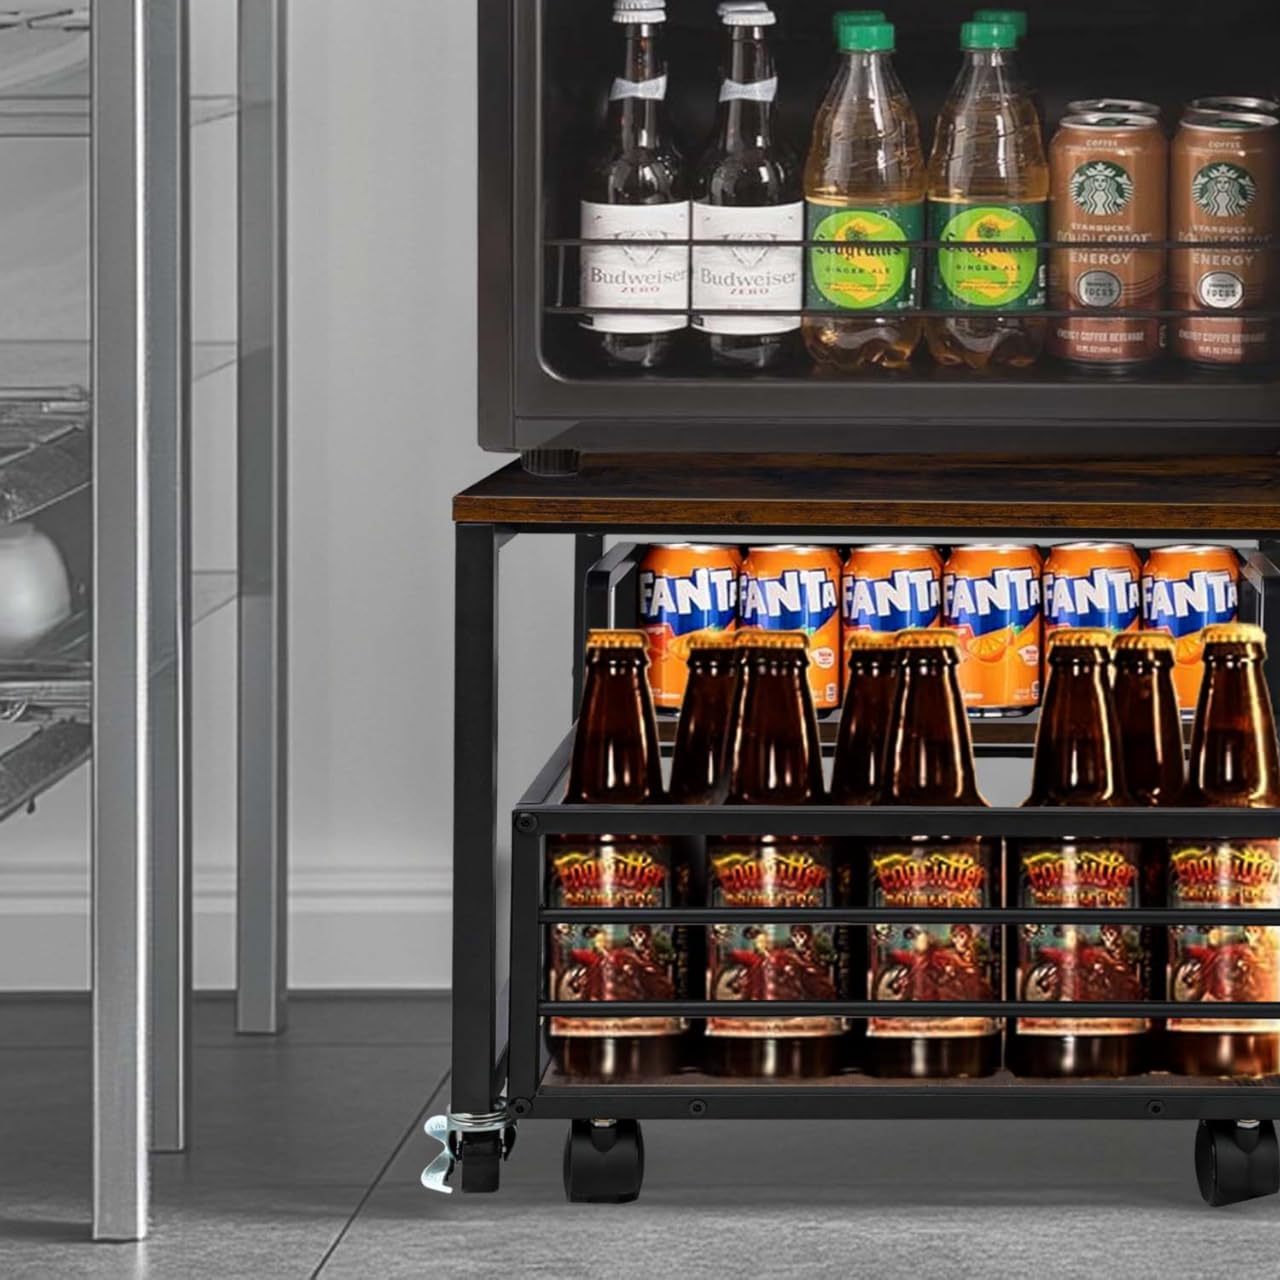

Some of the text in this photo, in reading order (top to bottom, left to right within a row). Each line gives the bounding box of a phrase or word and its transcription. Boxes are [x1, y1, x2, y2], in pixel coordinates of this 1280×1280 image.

[1070, 252, 1132, 265] ENERGY
[1190, 252, 1256, 266] ENERGY
[591, 266, 688, 287] Budweiser
[698, 267, 797, 288] Budweiser
[740, 569, 837, 618] FANTA
[943, 568, 1040, 618] FANTA
